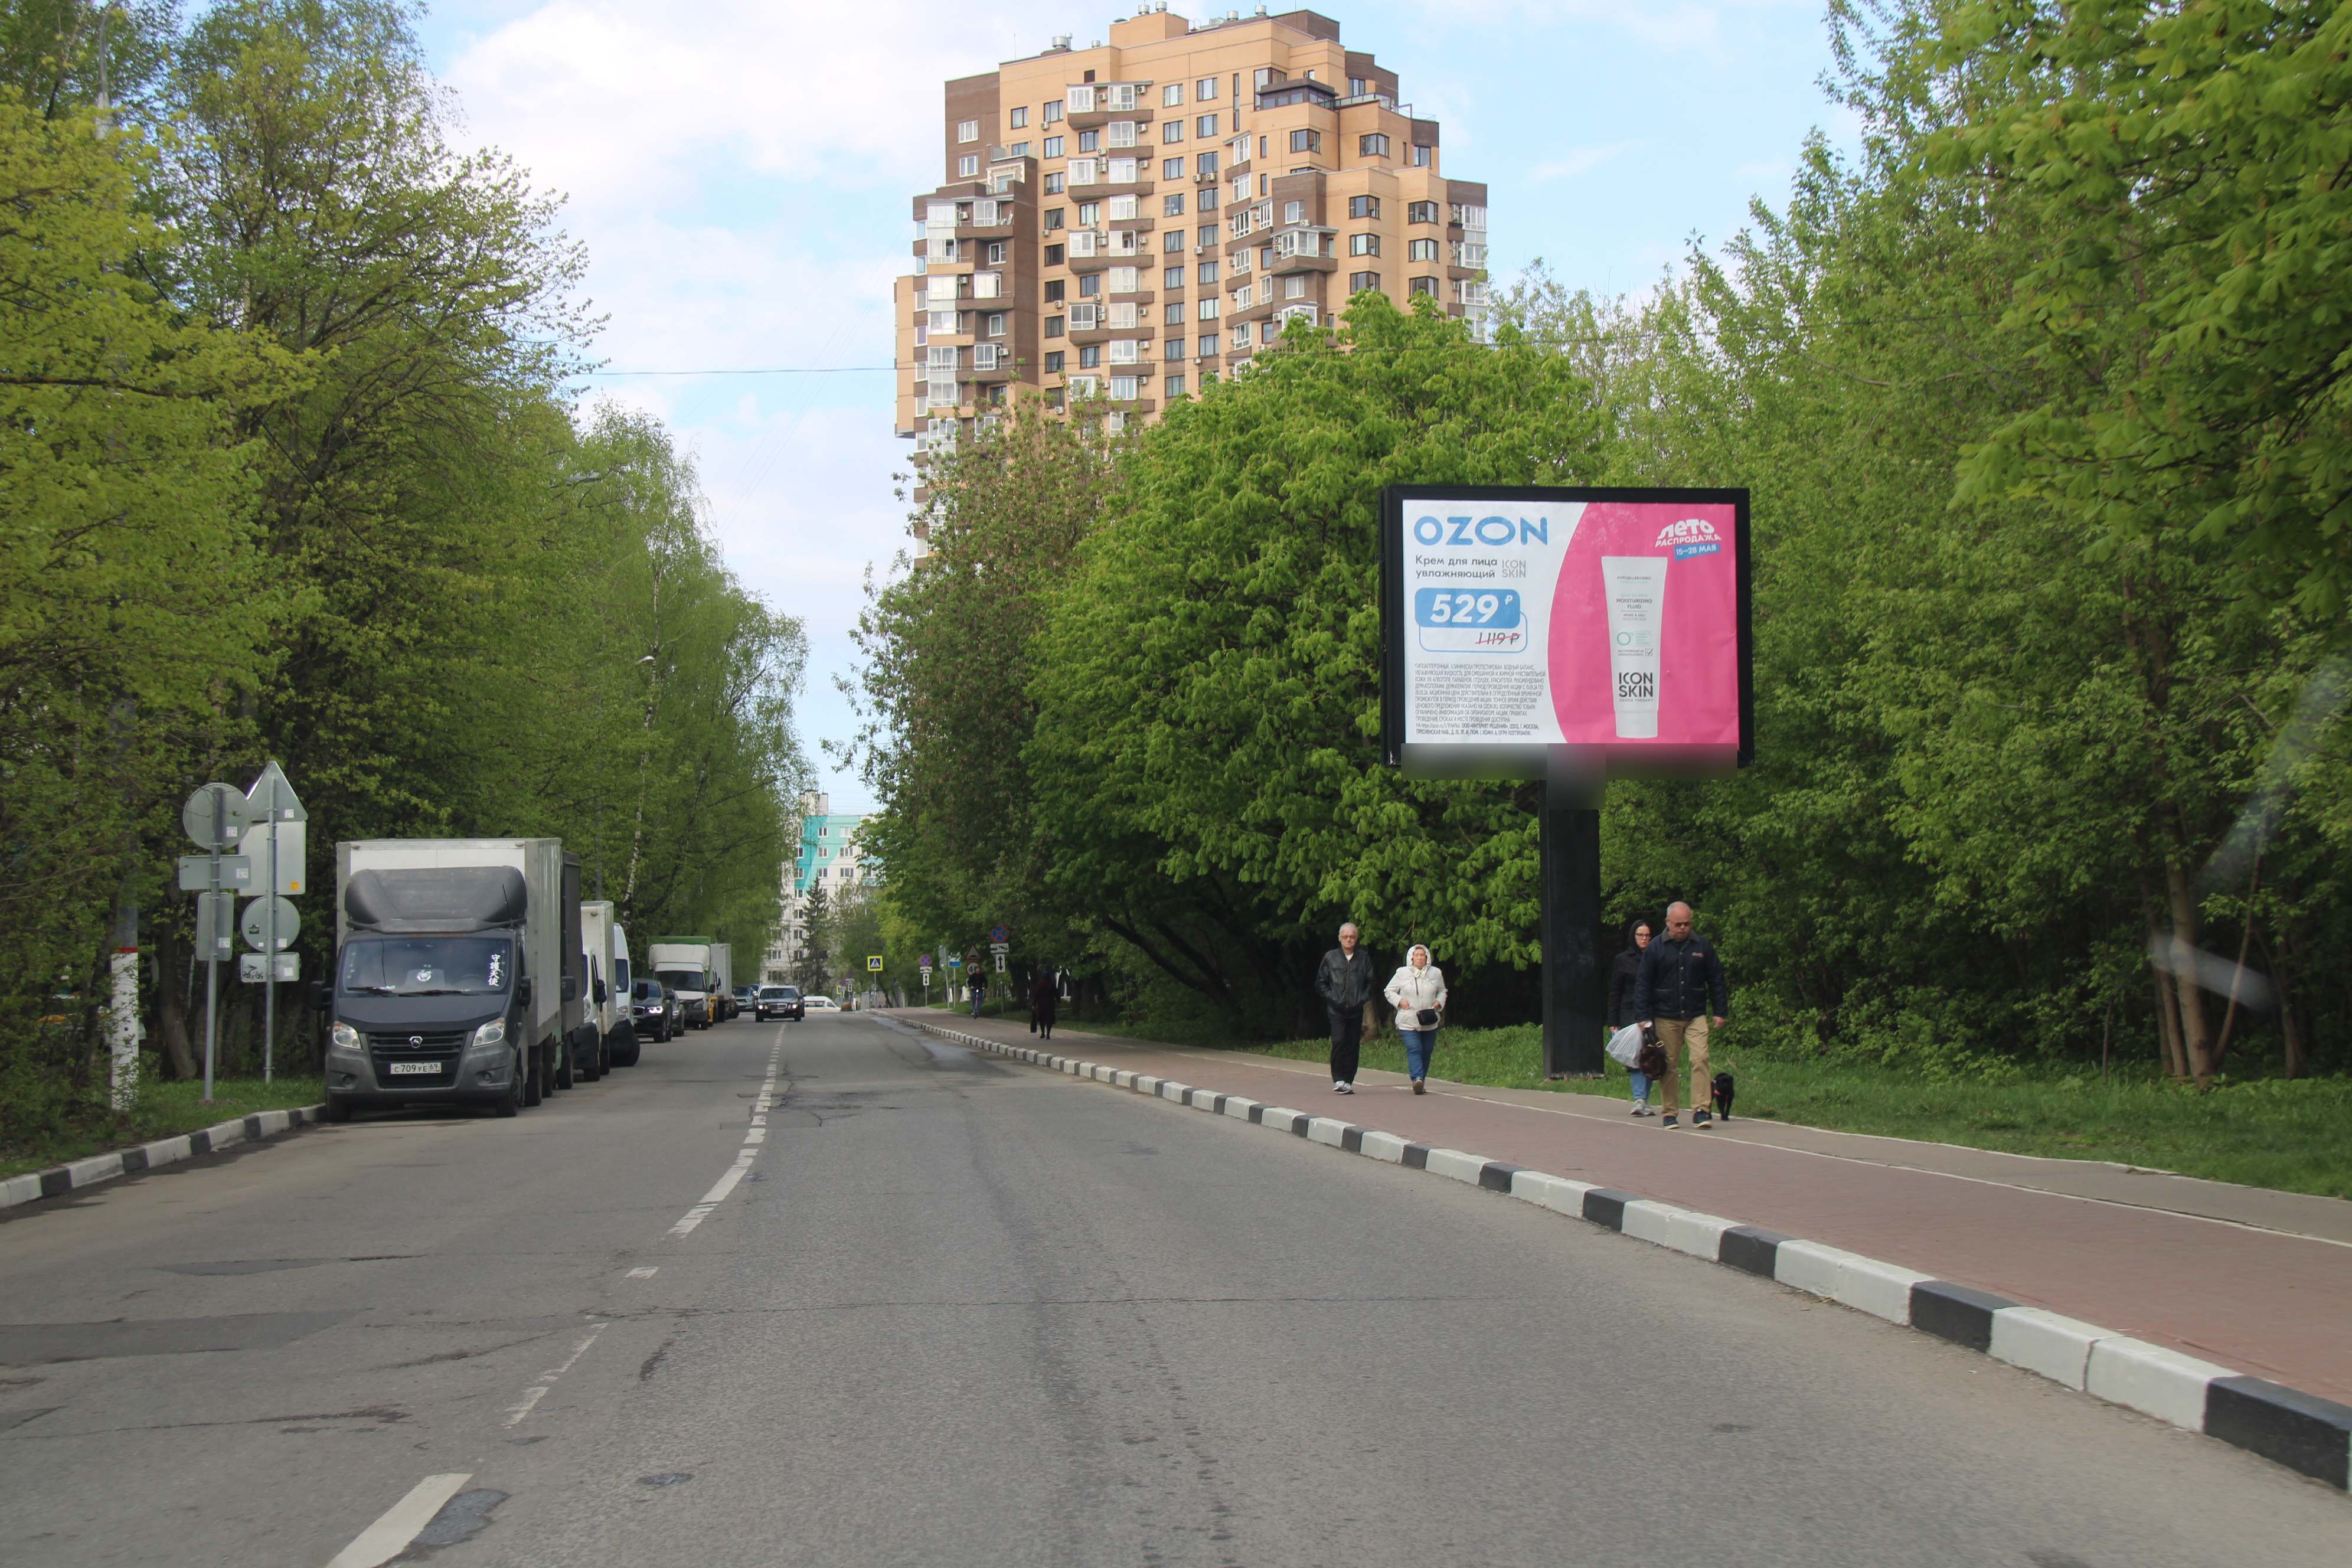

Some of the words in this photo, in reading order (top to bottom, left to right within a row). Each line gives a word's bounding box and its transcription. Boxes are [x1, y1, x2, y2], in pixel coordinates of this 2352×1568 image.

[1413, 516, 1548, 546] OZON
[1655, 534, 1722, 548] РАСПРОДАЖА
[1699, 544, 1717, 553] МАЯ
[1416, 555, 1444, 566] Крем
[1448, 557, 1468, 566] для
[1471, 557, 1498, 566] лица
[1502, 560, 1526, 569] ICON
[1416, 569, 1495, 579] увлажняющий
[1501, 569, 1526, 578] SKIN
[1430, 594, 1499, 623] 529
[1619, 672, 1653, 684] ICON
[1619, 685, 1653, 697] SKIN
